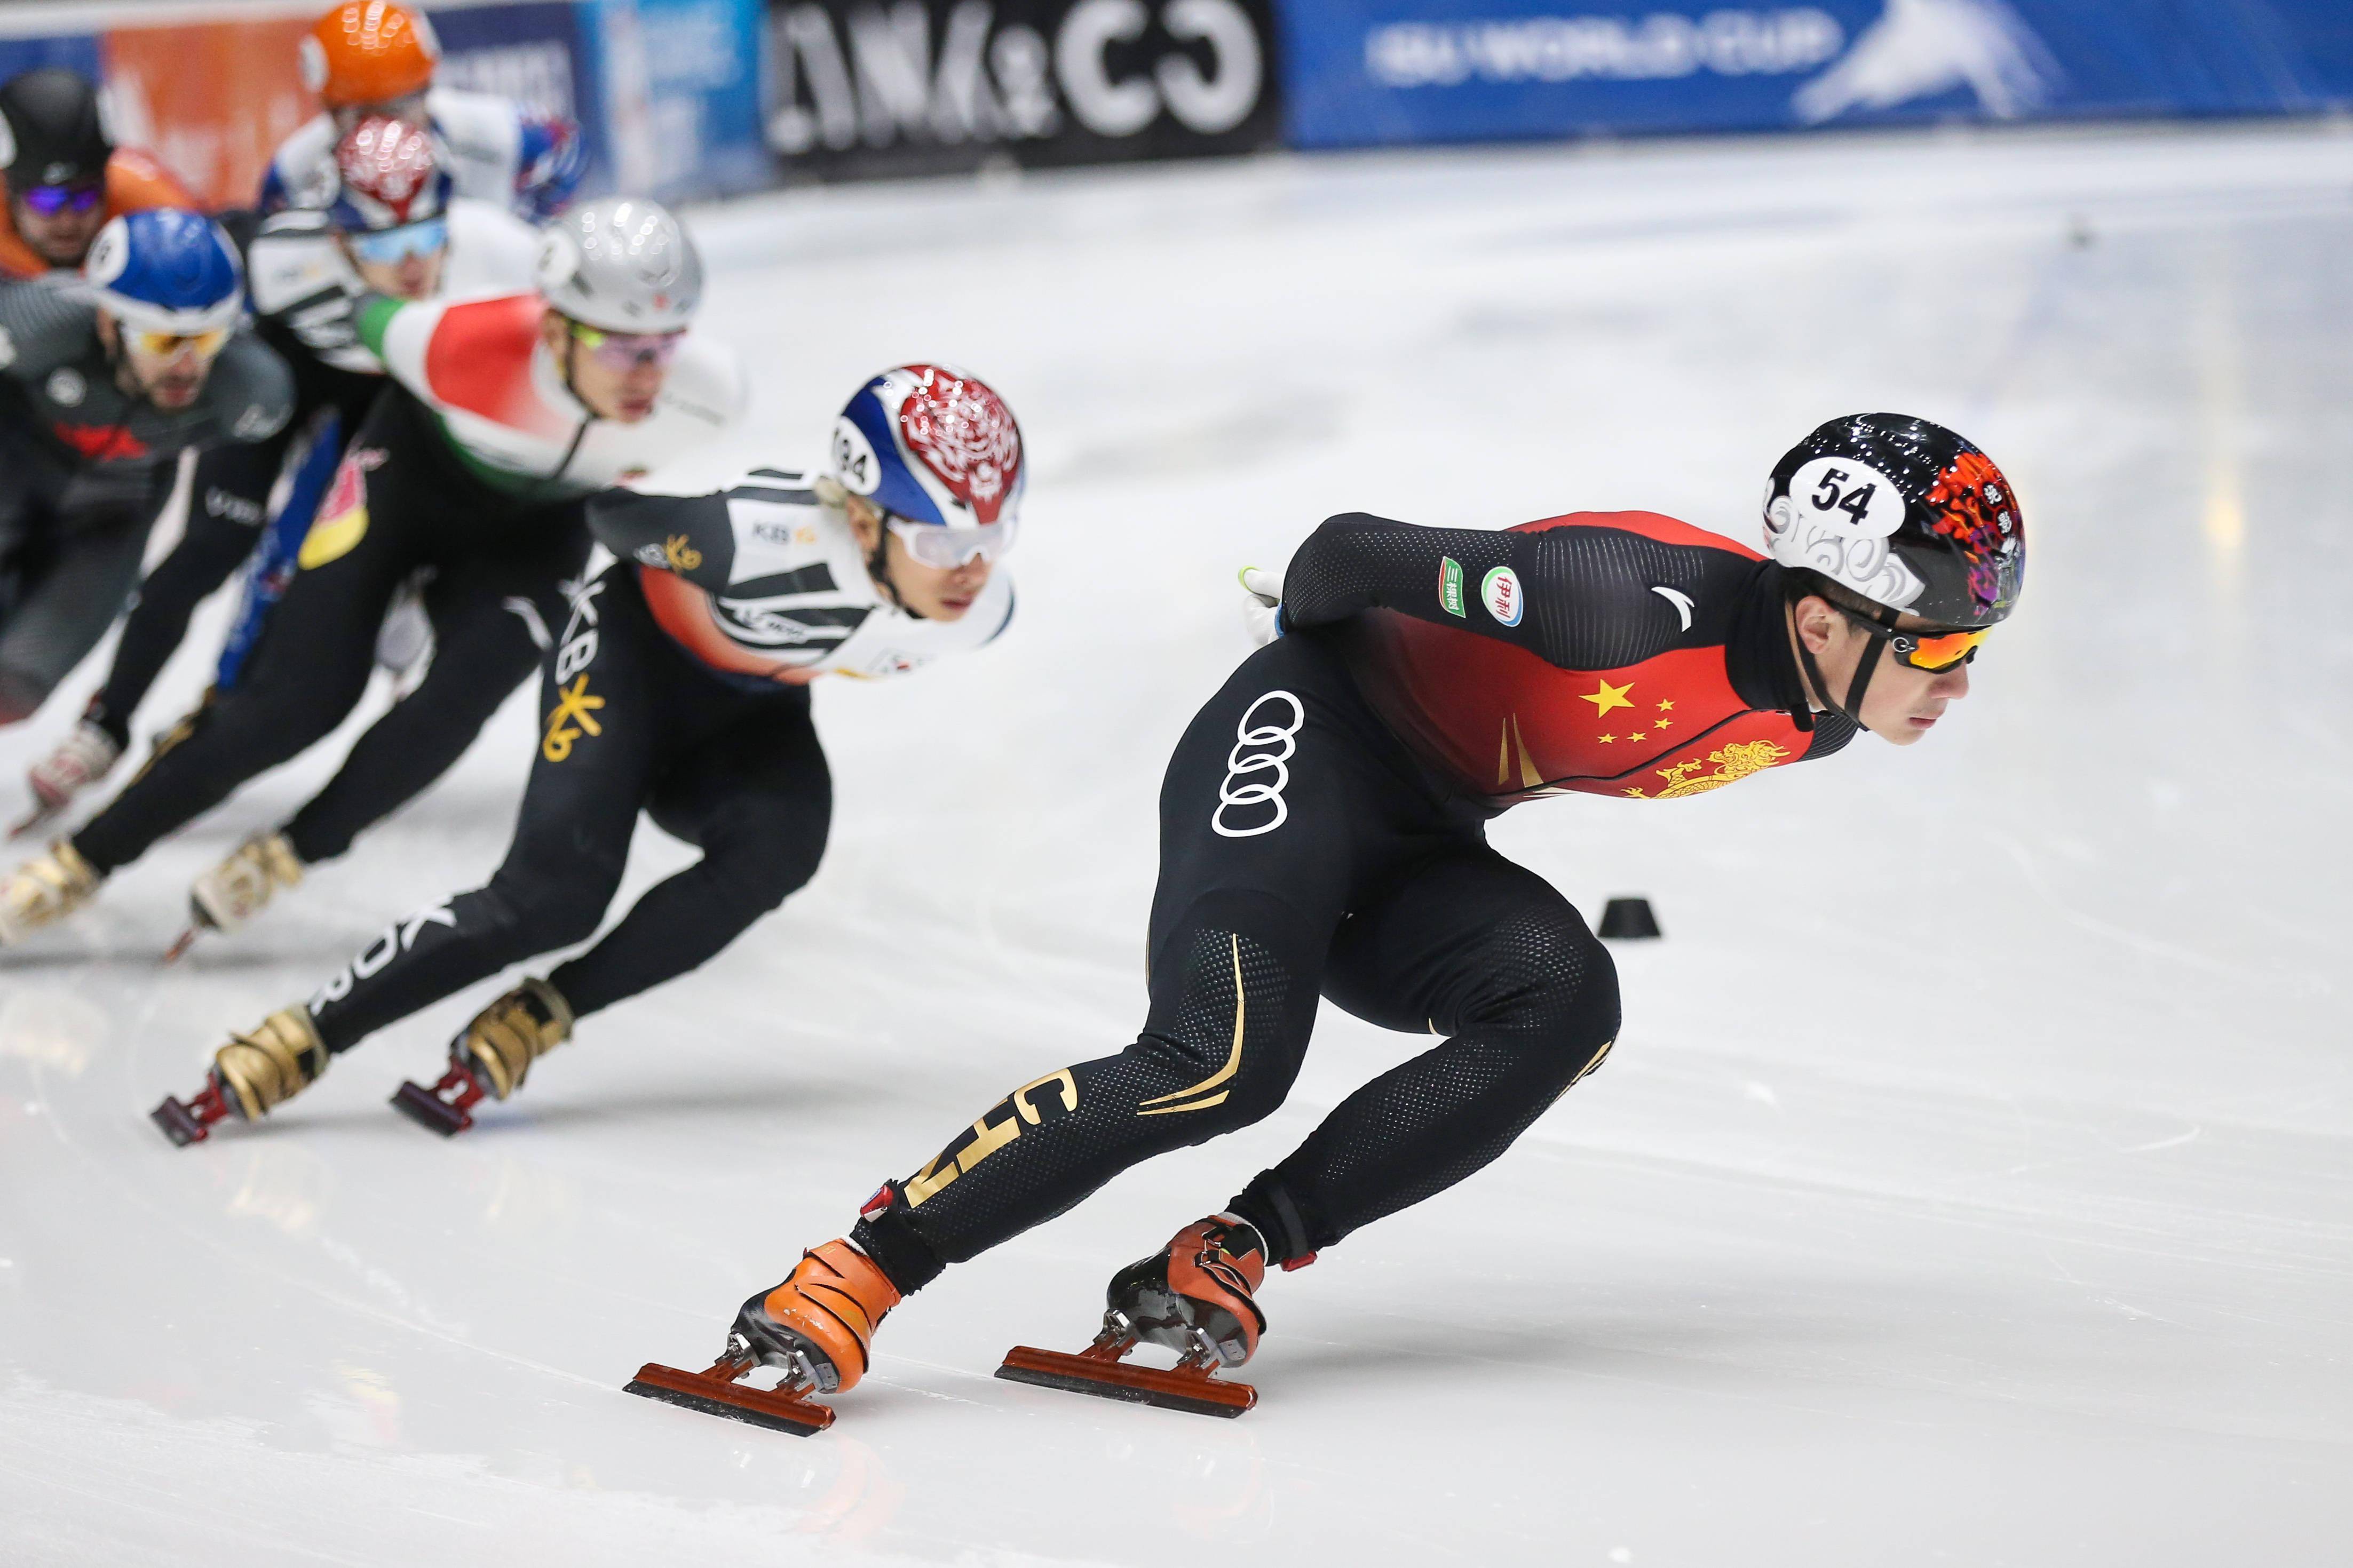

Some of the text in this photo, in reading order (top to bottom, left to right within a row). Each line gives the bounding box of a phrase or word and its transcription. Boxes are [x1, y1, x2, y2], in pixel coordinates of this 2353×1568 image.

[1471, 16, 1696, 81] WORLD
[1702, 10, 1841, 75] CUP
[1812, 467, 1877, 525] 54
[1495, 576, 1512, 618] 伊利
